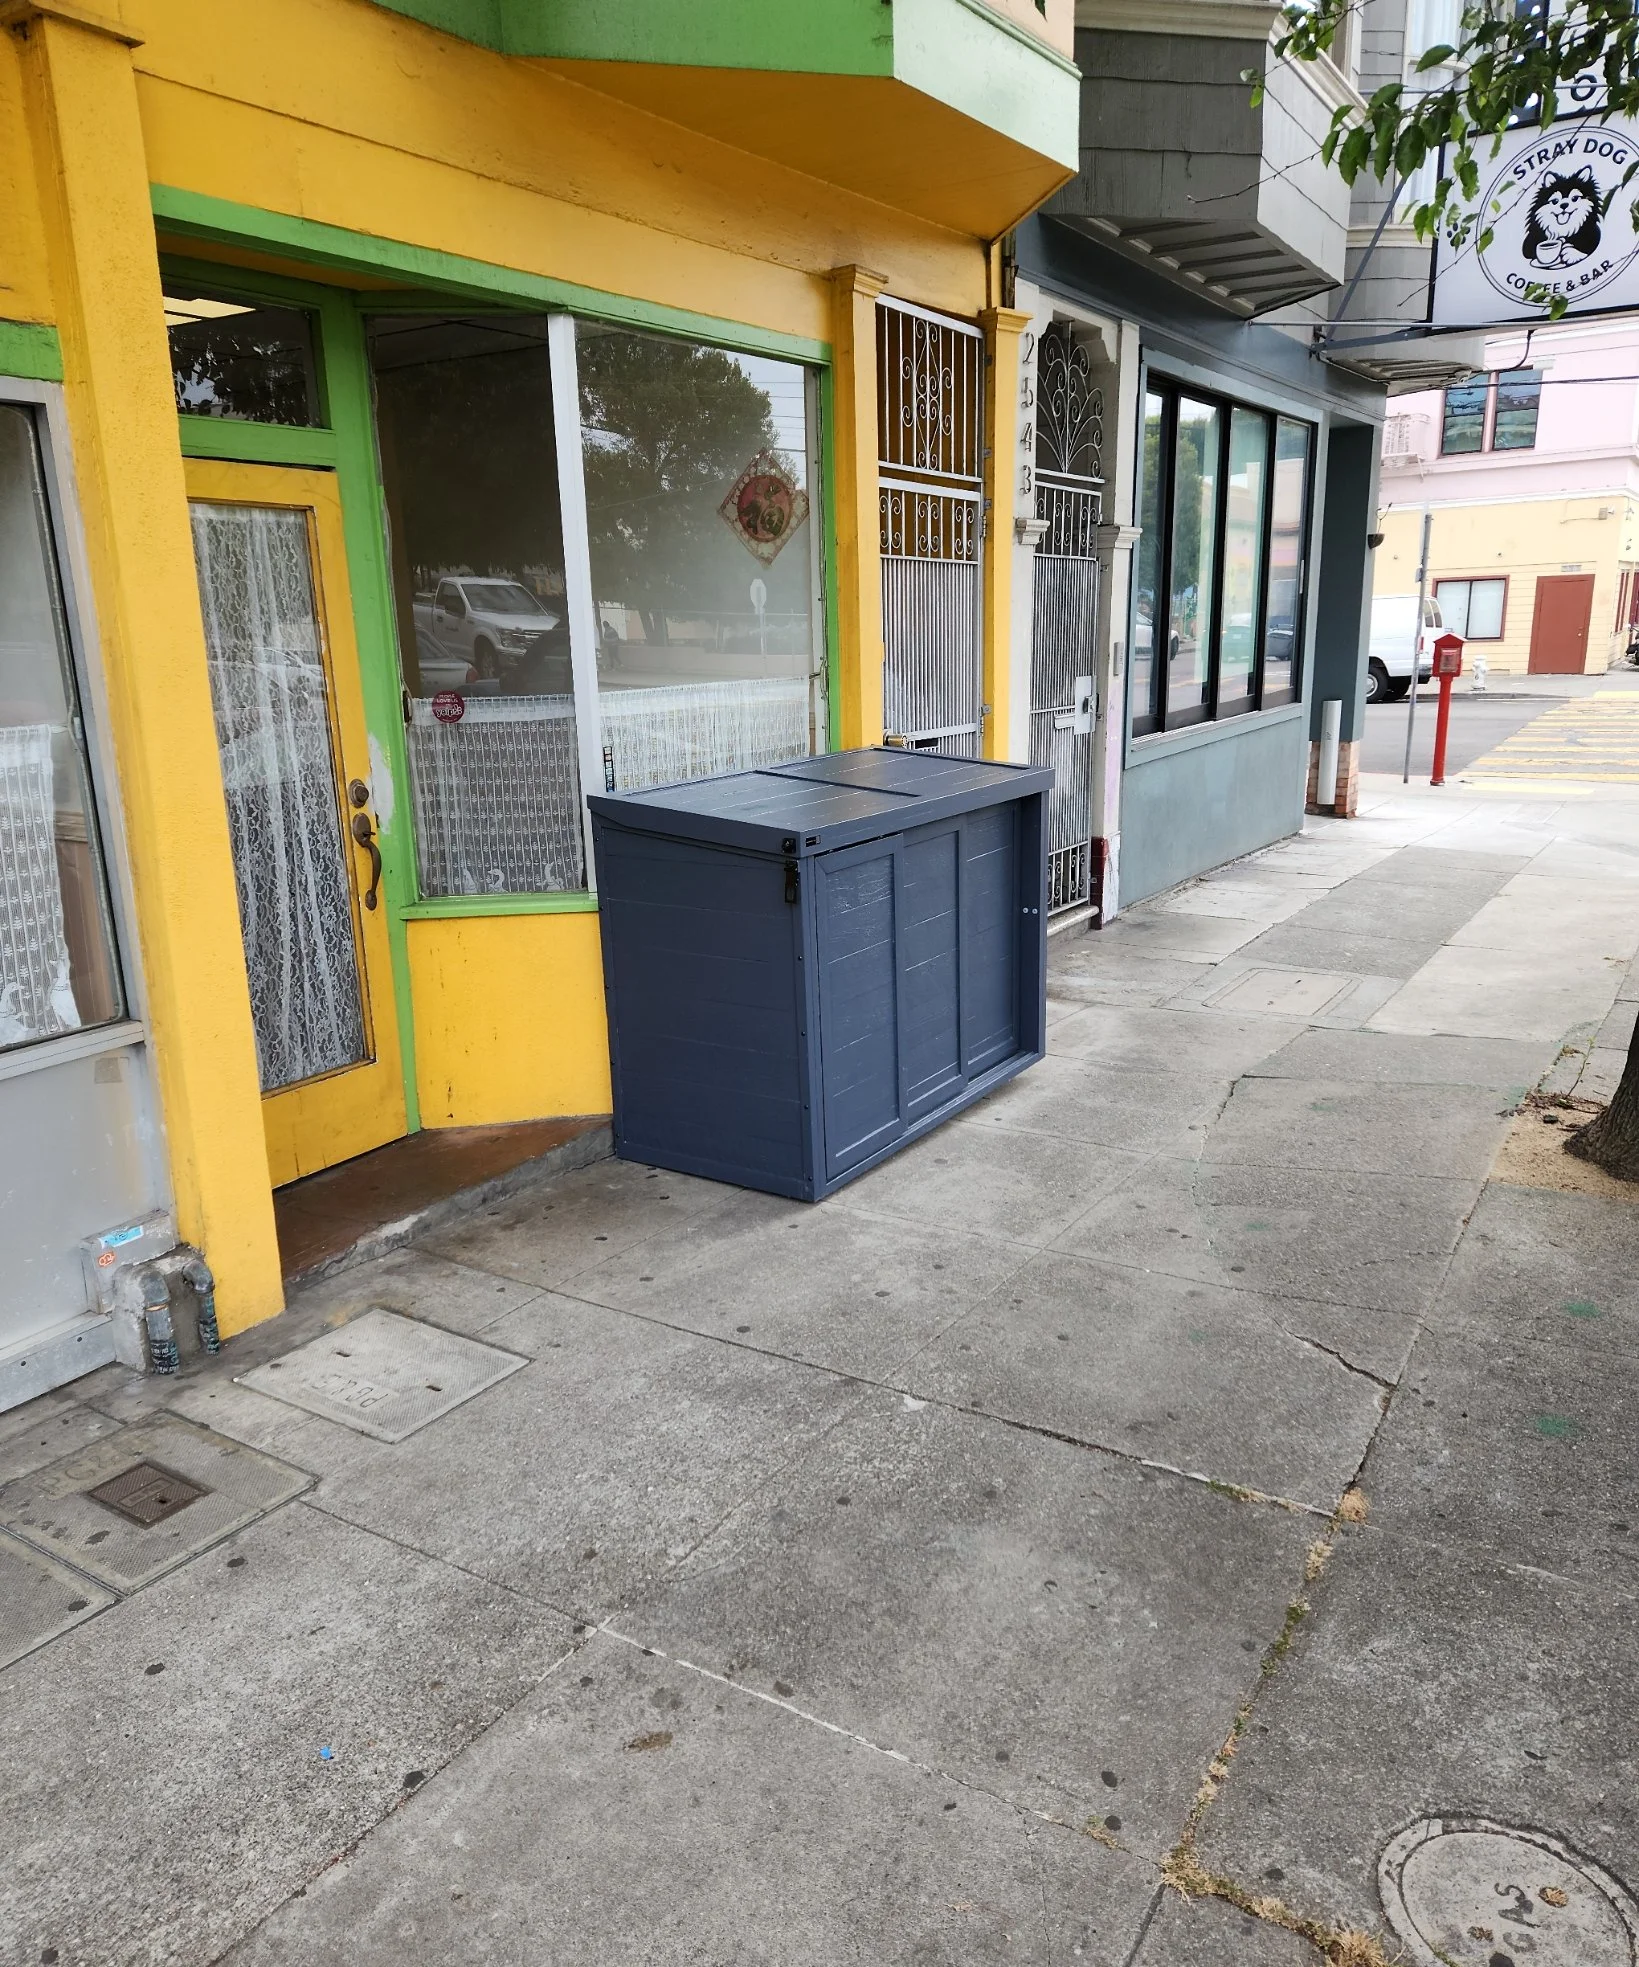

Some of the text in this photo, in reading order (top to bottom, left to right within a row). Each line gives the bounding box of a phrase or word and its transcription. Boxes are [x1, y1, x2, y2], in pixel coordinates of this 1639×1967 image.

[1513, 138, 1628, 180] STRAY DOG
[1566, 279, 1576, 292] &
[1580, 260, 1613, 286] BAR
[1019, 332, 1035, 495] 2543
